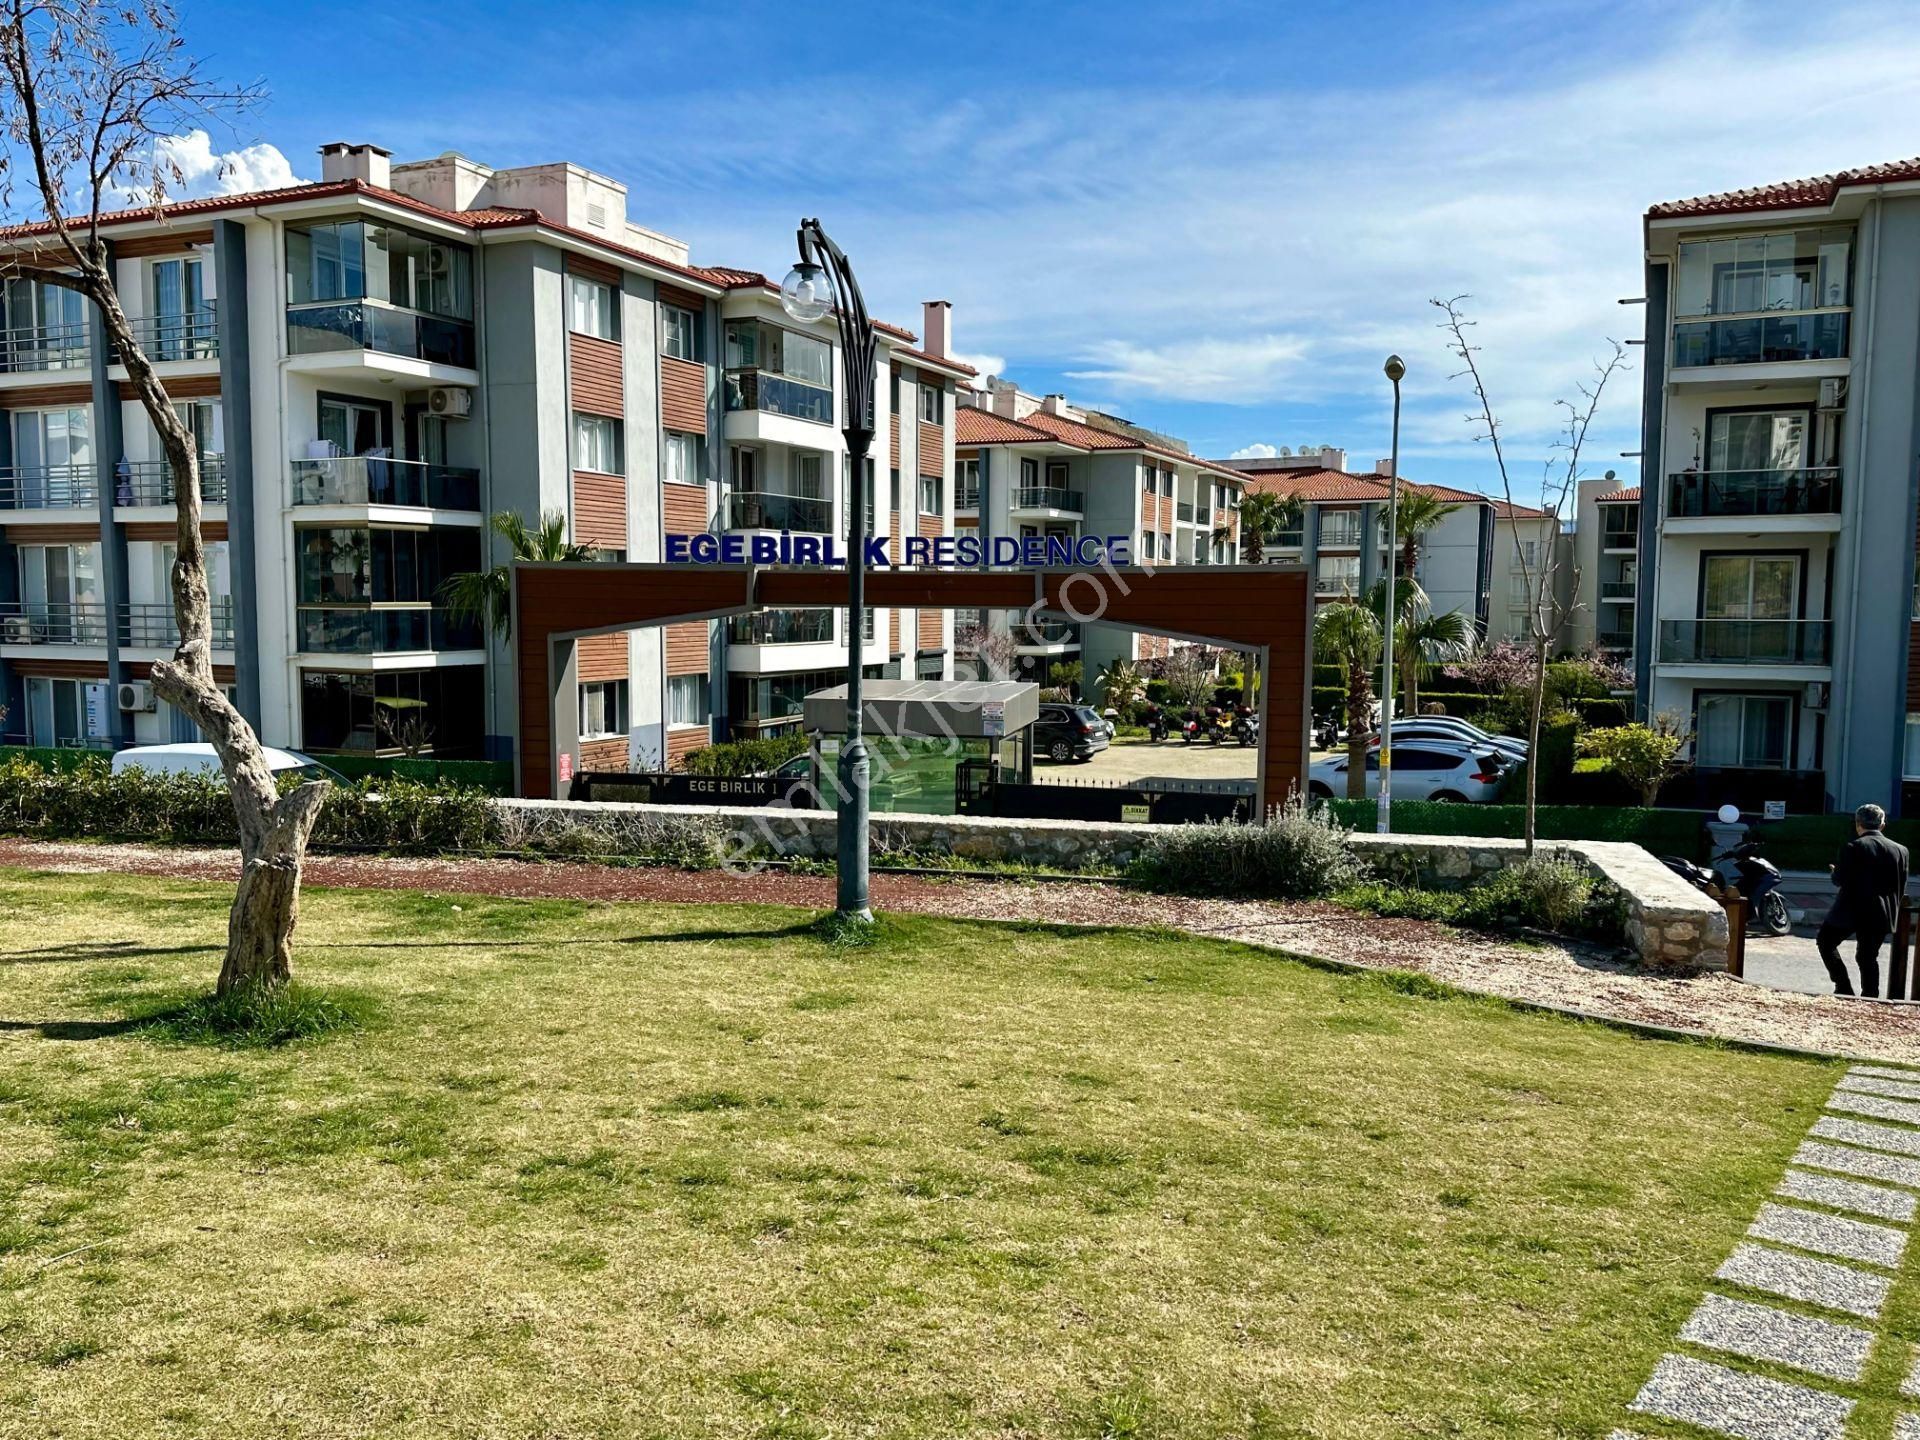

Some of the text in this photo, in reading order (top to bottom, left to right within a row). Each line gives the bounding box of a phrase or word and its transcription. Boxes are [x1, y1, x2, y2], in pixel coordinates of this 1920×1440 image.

[665, 529, 1130, 566] EGE BİRLK RESIDENCE
[689, 780, 715, 792] EGE
